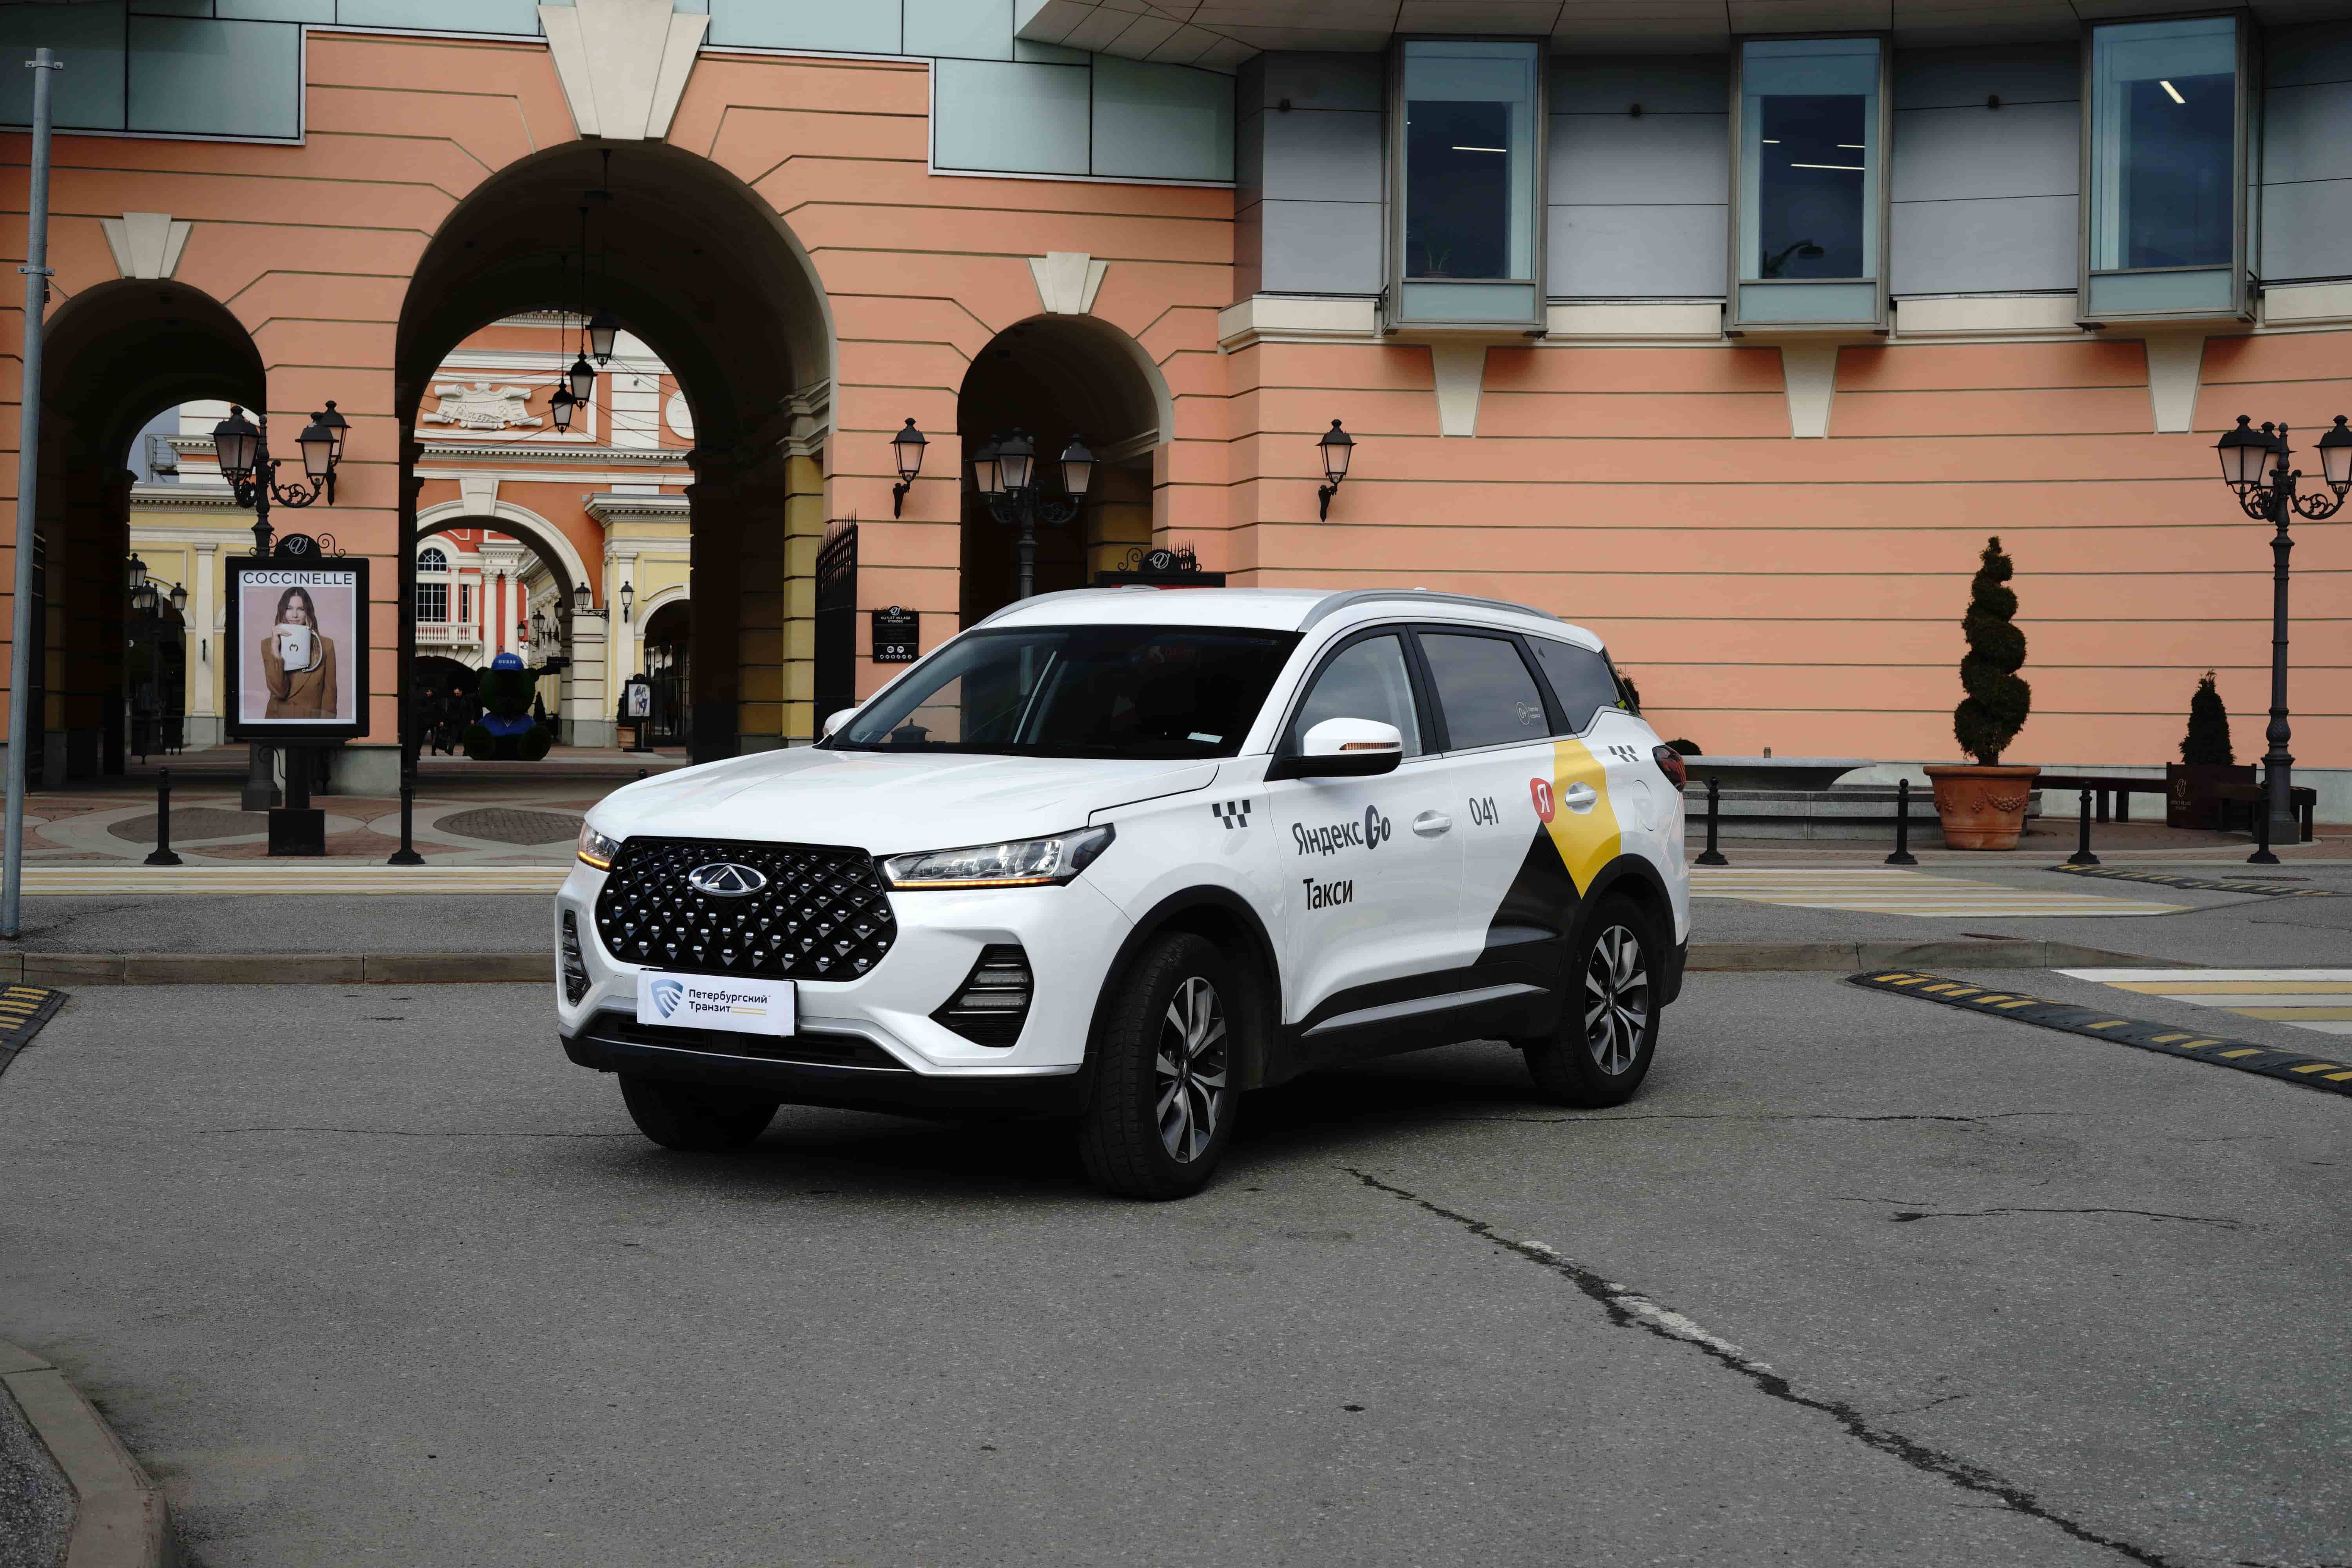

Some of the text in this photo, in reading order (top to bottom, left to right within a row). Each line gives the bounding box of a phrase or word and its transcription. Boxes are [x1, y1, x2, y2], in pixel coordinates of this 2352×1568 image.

[243, 572, 352, 584] COCCINELLE
[1469, 796, 1499, 826] 041
[1537, 784, 1550, 813] Я
[1292, 804, 1391, 857] Яндекс Go
[1303, 878, 1353, 910] Такси
[689, 989, 768, 1004] Петербургский
[689, 1001, 731, 1013] Транзит
